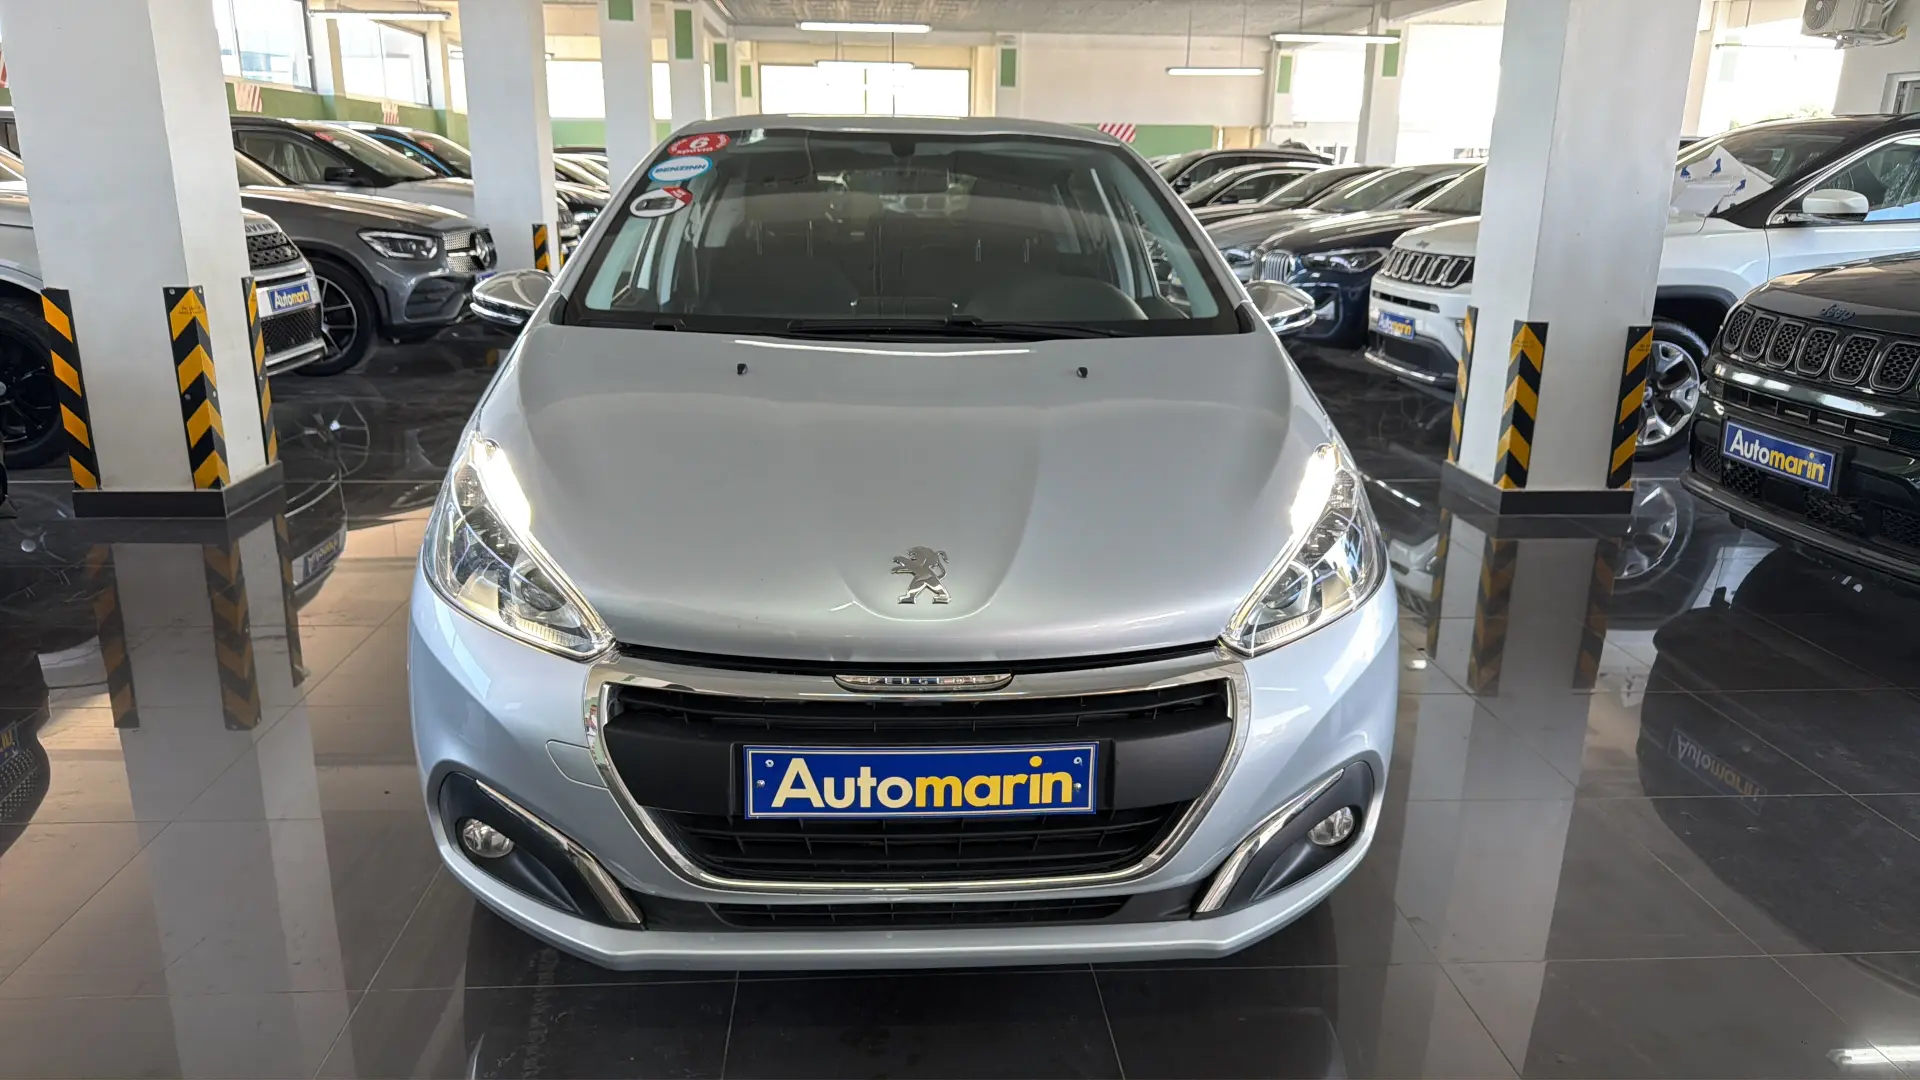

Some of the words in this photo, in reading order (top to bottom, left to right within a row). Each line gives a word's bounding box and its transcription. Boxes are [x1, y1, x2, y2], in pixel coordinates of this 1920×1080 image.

[274, 285, 310, 309] Automarin
[1729, 428, 1825, 482] Automarin
[771, 755, 1073, 809] Automarin
